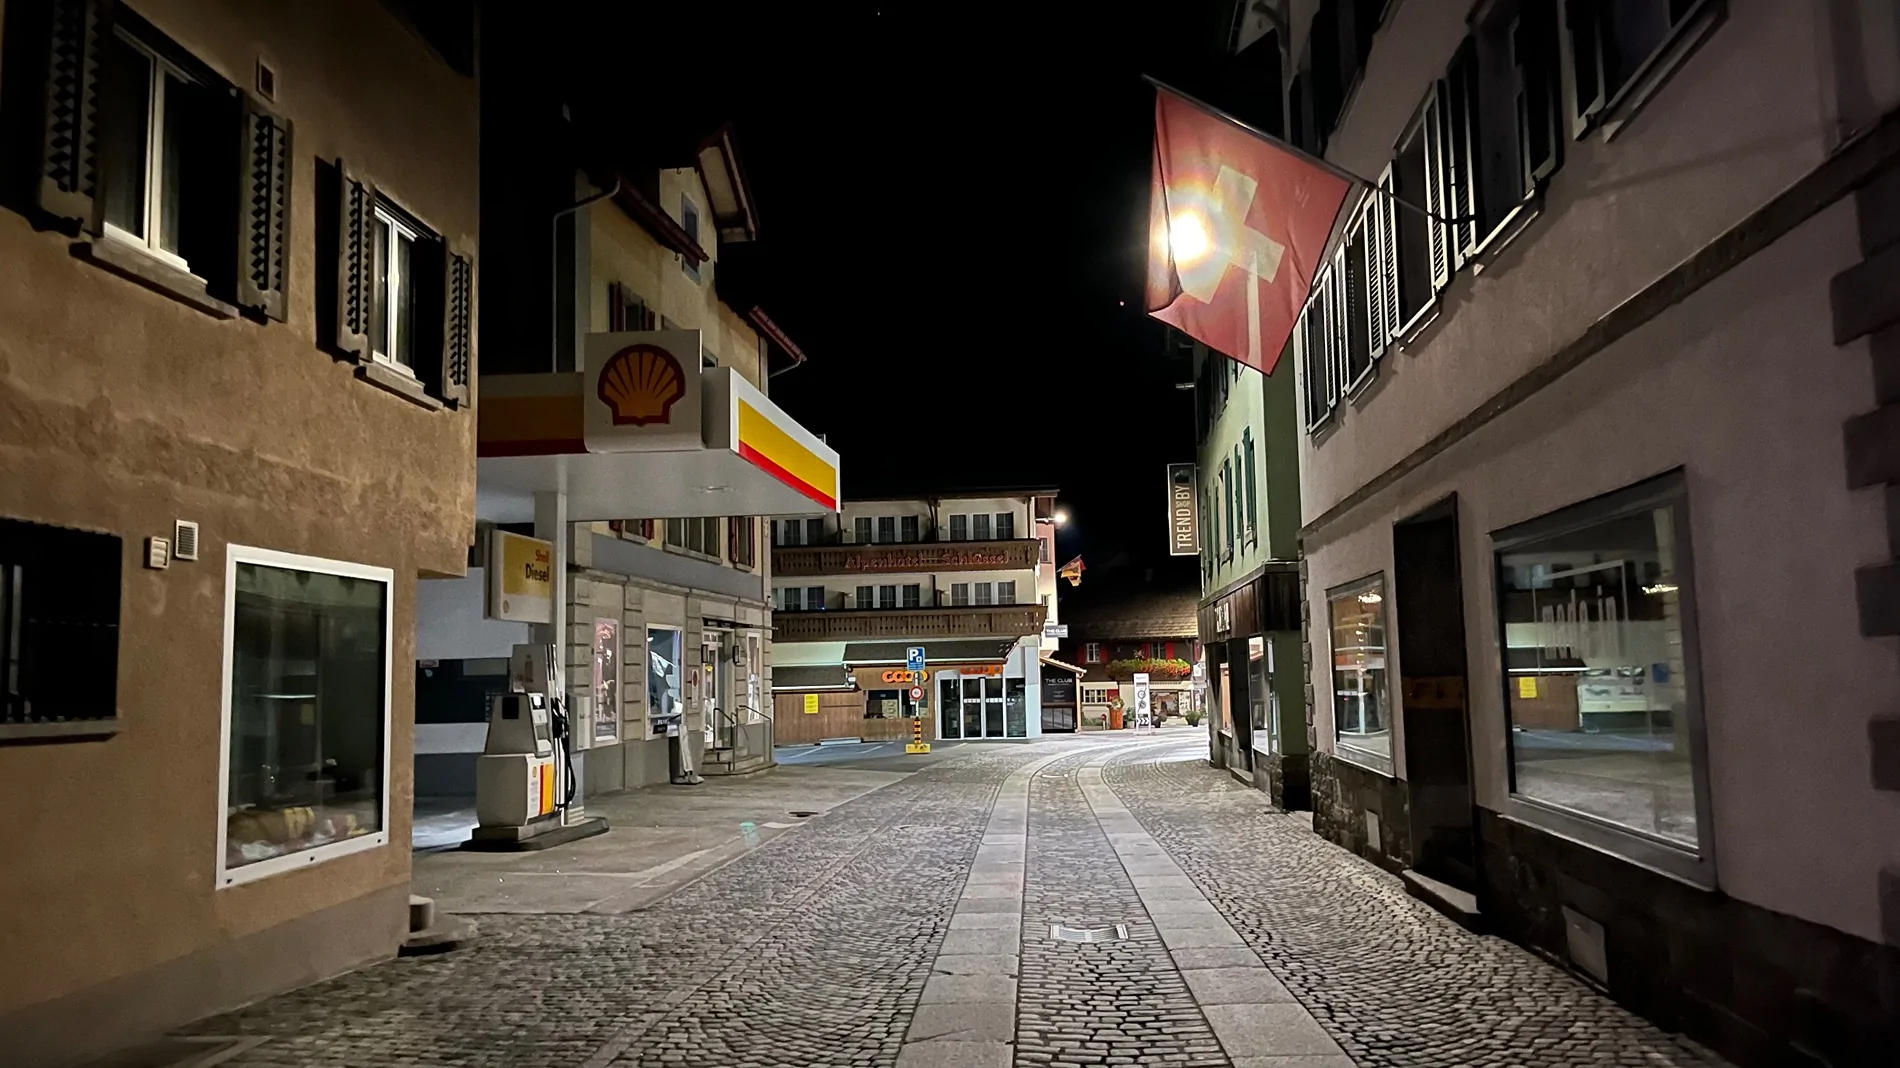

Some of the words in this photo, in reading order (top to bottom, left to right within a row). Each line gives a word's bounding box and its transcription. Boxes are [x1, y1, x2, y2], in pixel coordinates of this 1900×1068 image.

[1175, 485, 1191, 500] BY
[1175, 508, 1193, 550] TREND
[844, 551, 925, 571] Alpenhotel
[940, 550, 1009, 566] Schlüssel
[525, 563, 550, 582] Diesel
